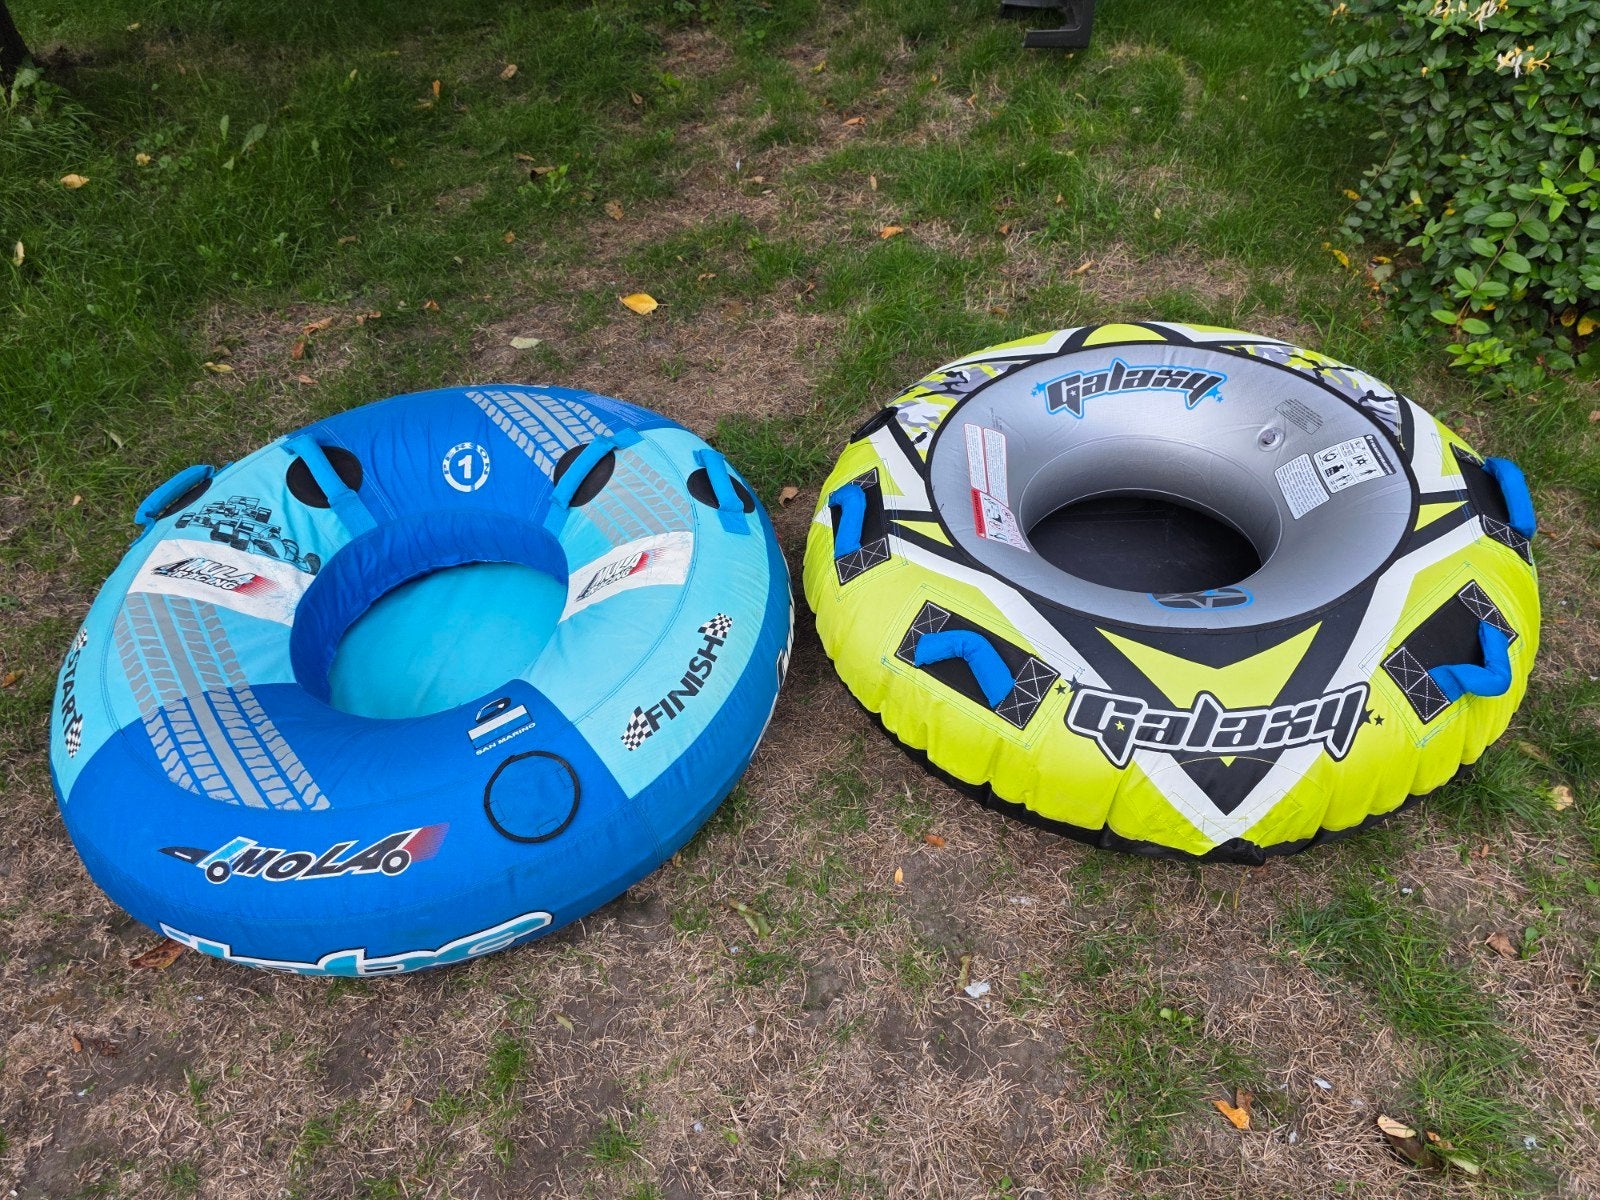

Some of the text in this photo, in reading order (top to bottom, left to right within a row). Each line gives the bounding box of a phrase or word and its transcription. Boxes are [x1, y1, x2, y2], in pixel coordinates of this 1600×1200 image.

[1045, 359, 1227, 418] Galaxy
[457, 454, 473, 479] 1
[61, 649, 83, 736] START
[643, 634, 725, 733] FINISH
[475, 722, 536, 756] SAN MARINO
[1064, 680, 1369, 769] Galaxy
[196, 828, 422, 885] IMOLA
